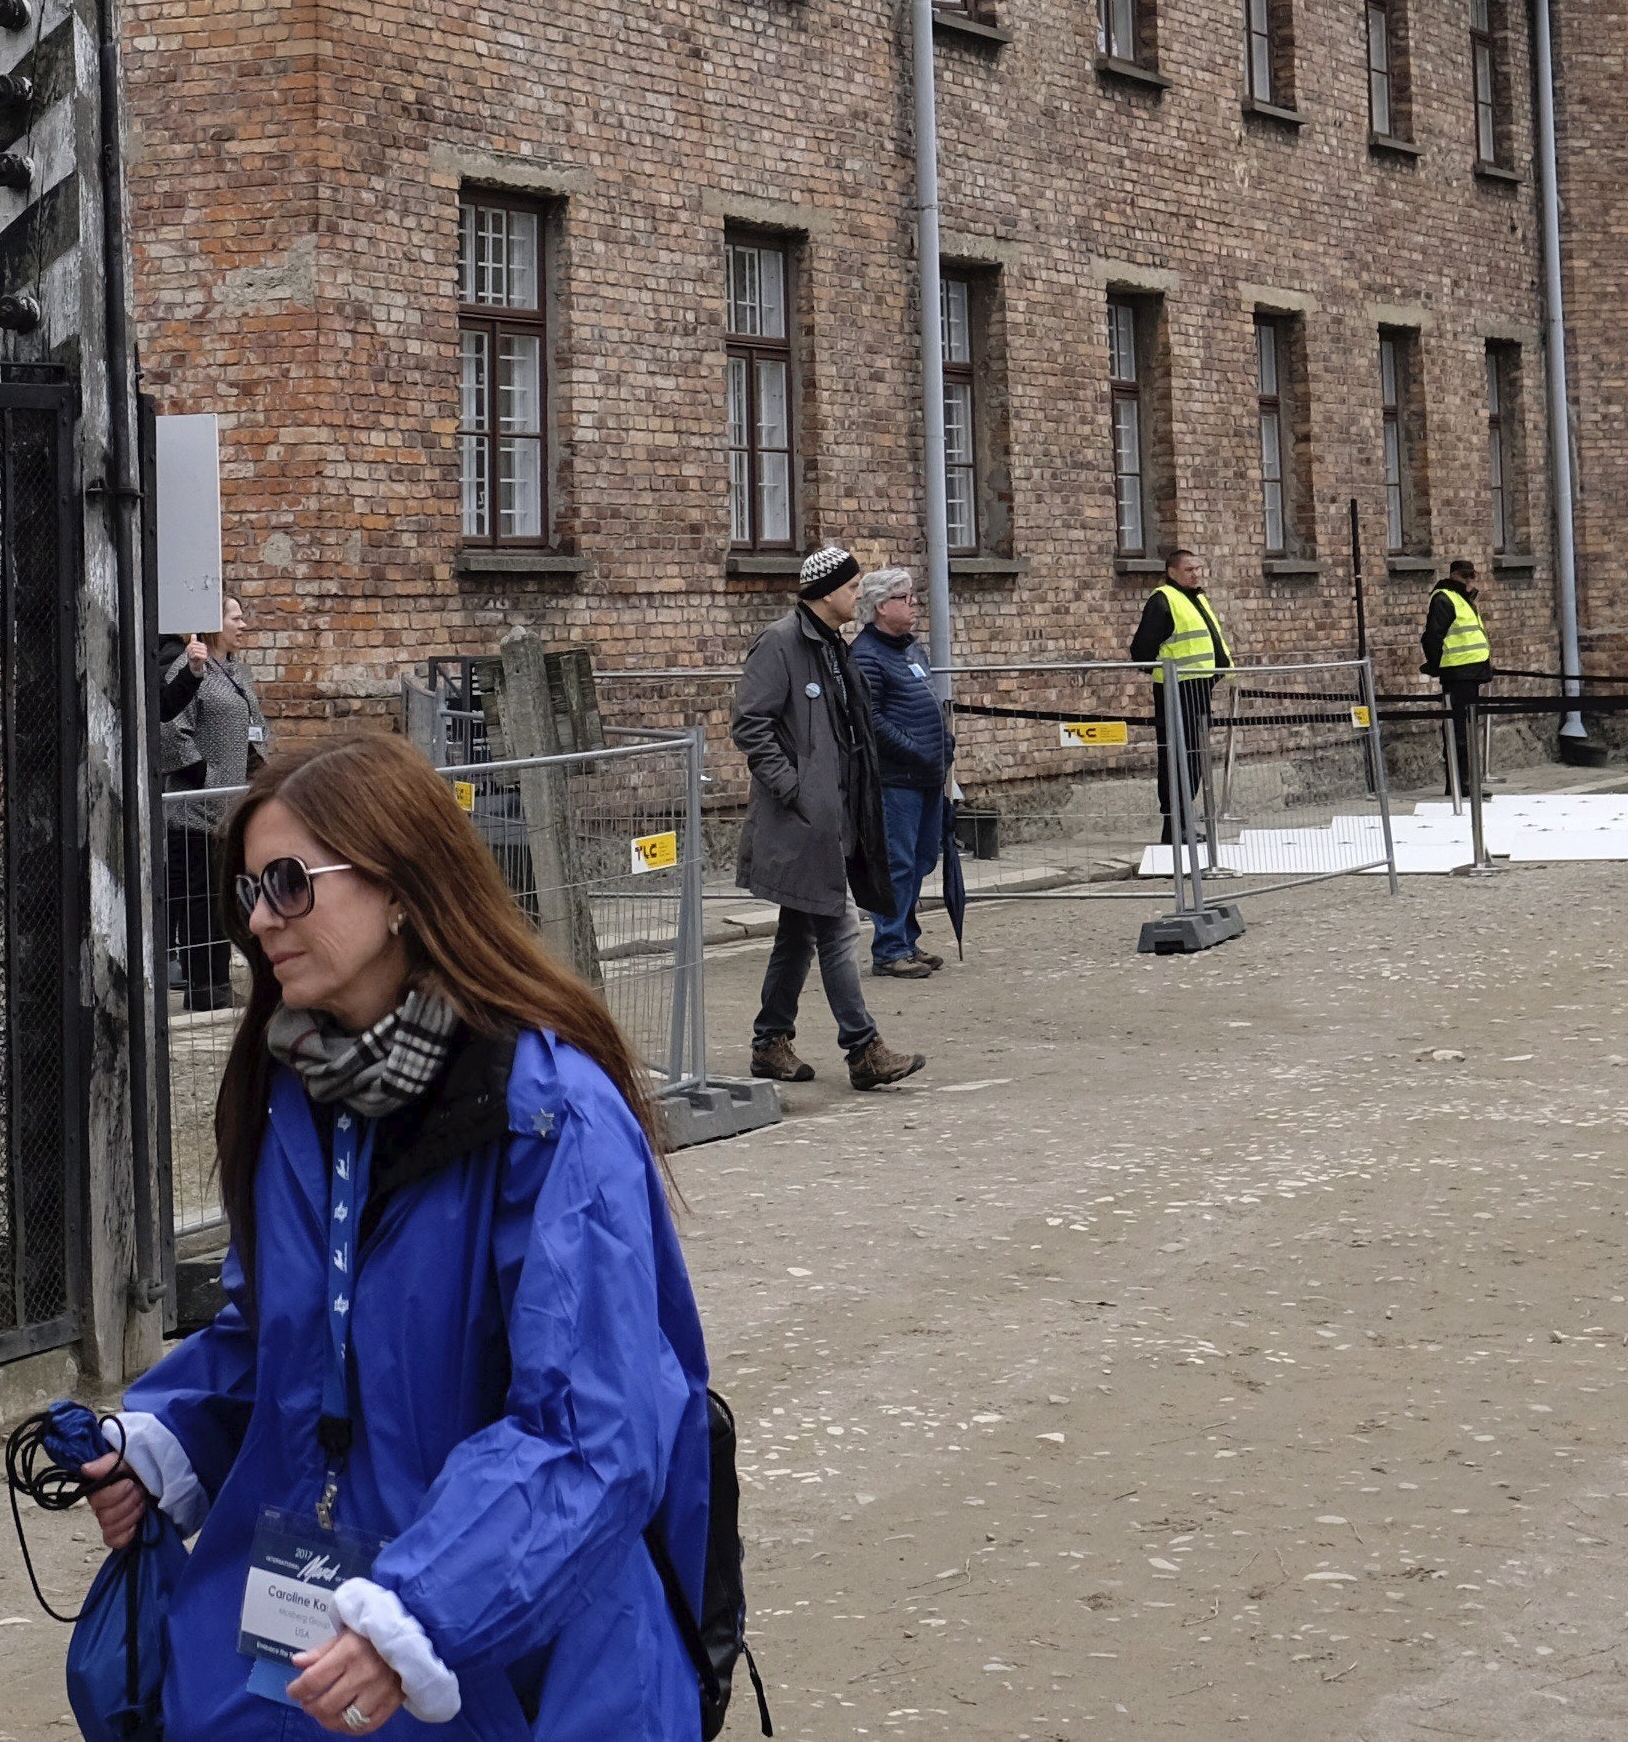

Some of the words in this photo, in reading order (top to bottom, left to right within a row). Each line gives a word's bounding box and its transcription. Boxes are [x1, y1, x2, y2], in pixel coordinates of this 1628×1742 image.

[1063, 728, 1097, 738] TLC
[635, 843, 657, 861] TLC
[295, 1547, 313, 1561] 2017
[268, 1585, 311, 1607] Caroline
[295, 1626, 310, 1638] USA
